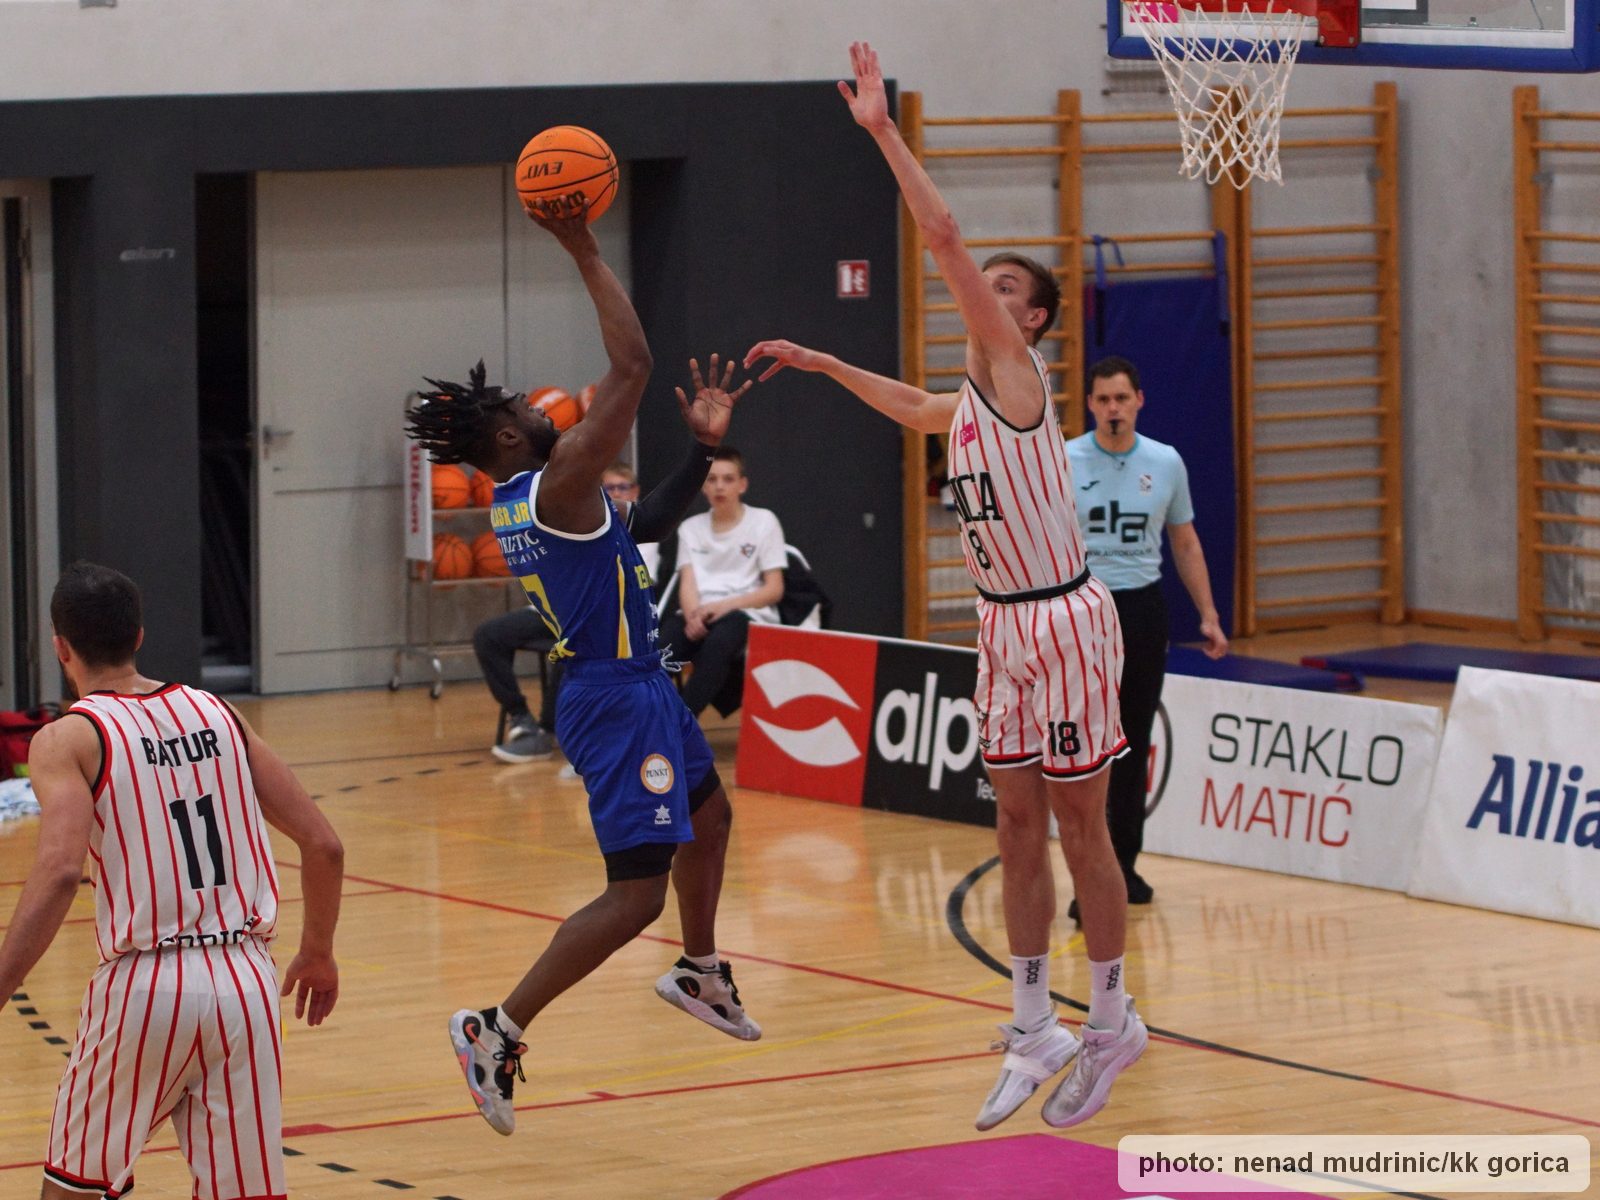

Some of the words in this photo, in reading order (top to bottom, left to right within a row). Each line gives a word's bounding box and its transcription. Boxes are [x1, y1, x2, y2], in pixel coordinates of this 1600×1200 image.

[968, 529, 991, 570] 8
[141, 728, 222, 768] BATUR
[874, 672, 980, 791] alp
[1048, 720, 1081, 757] 18
[1208, 713, 1404, 787] STAKLO
[1200, 777, 1352, 848] MATIĆ
[1465, 753, 1600, 851] Allia
[169, 794, 227, 890] 11
